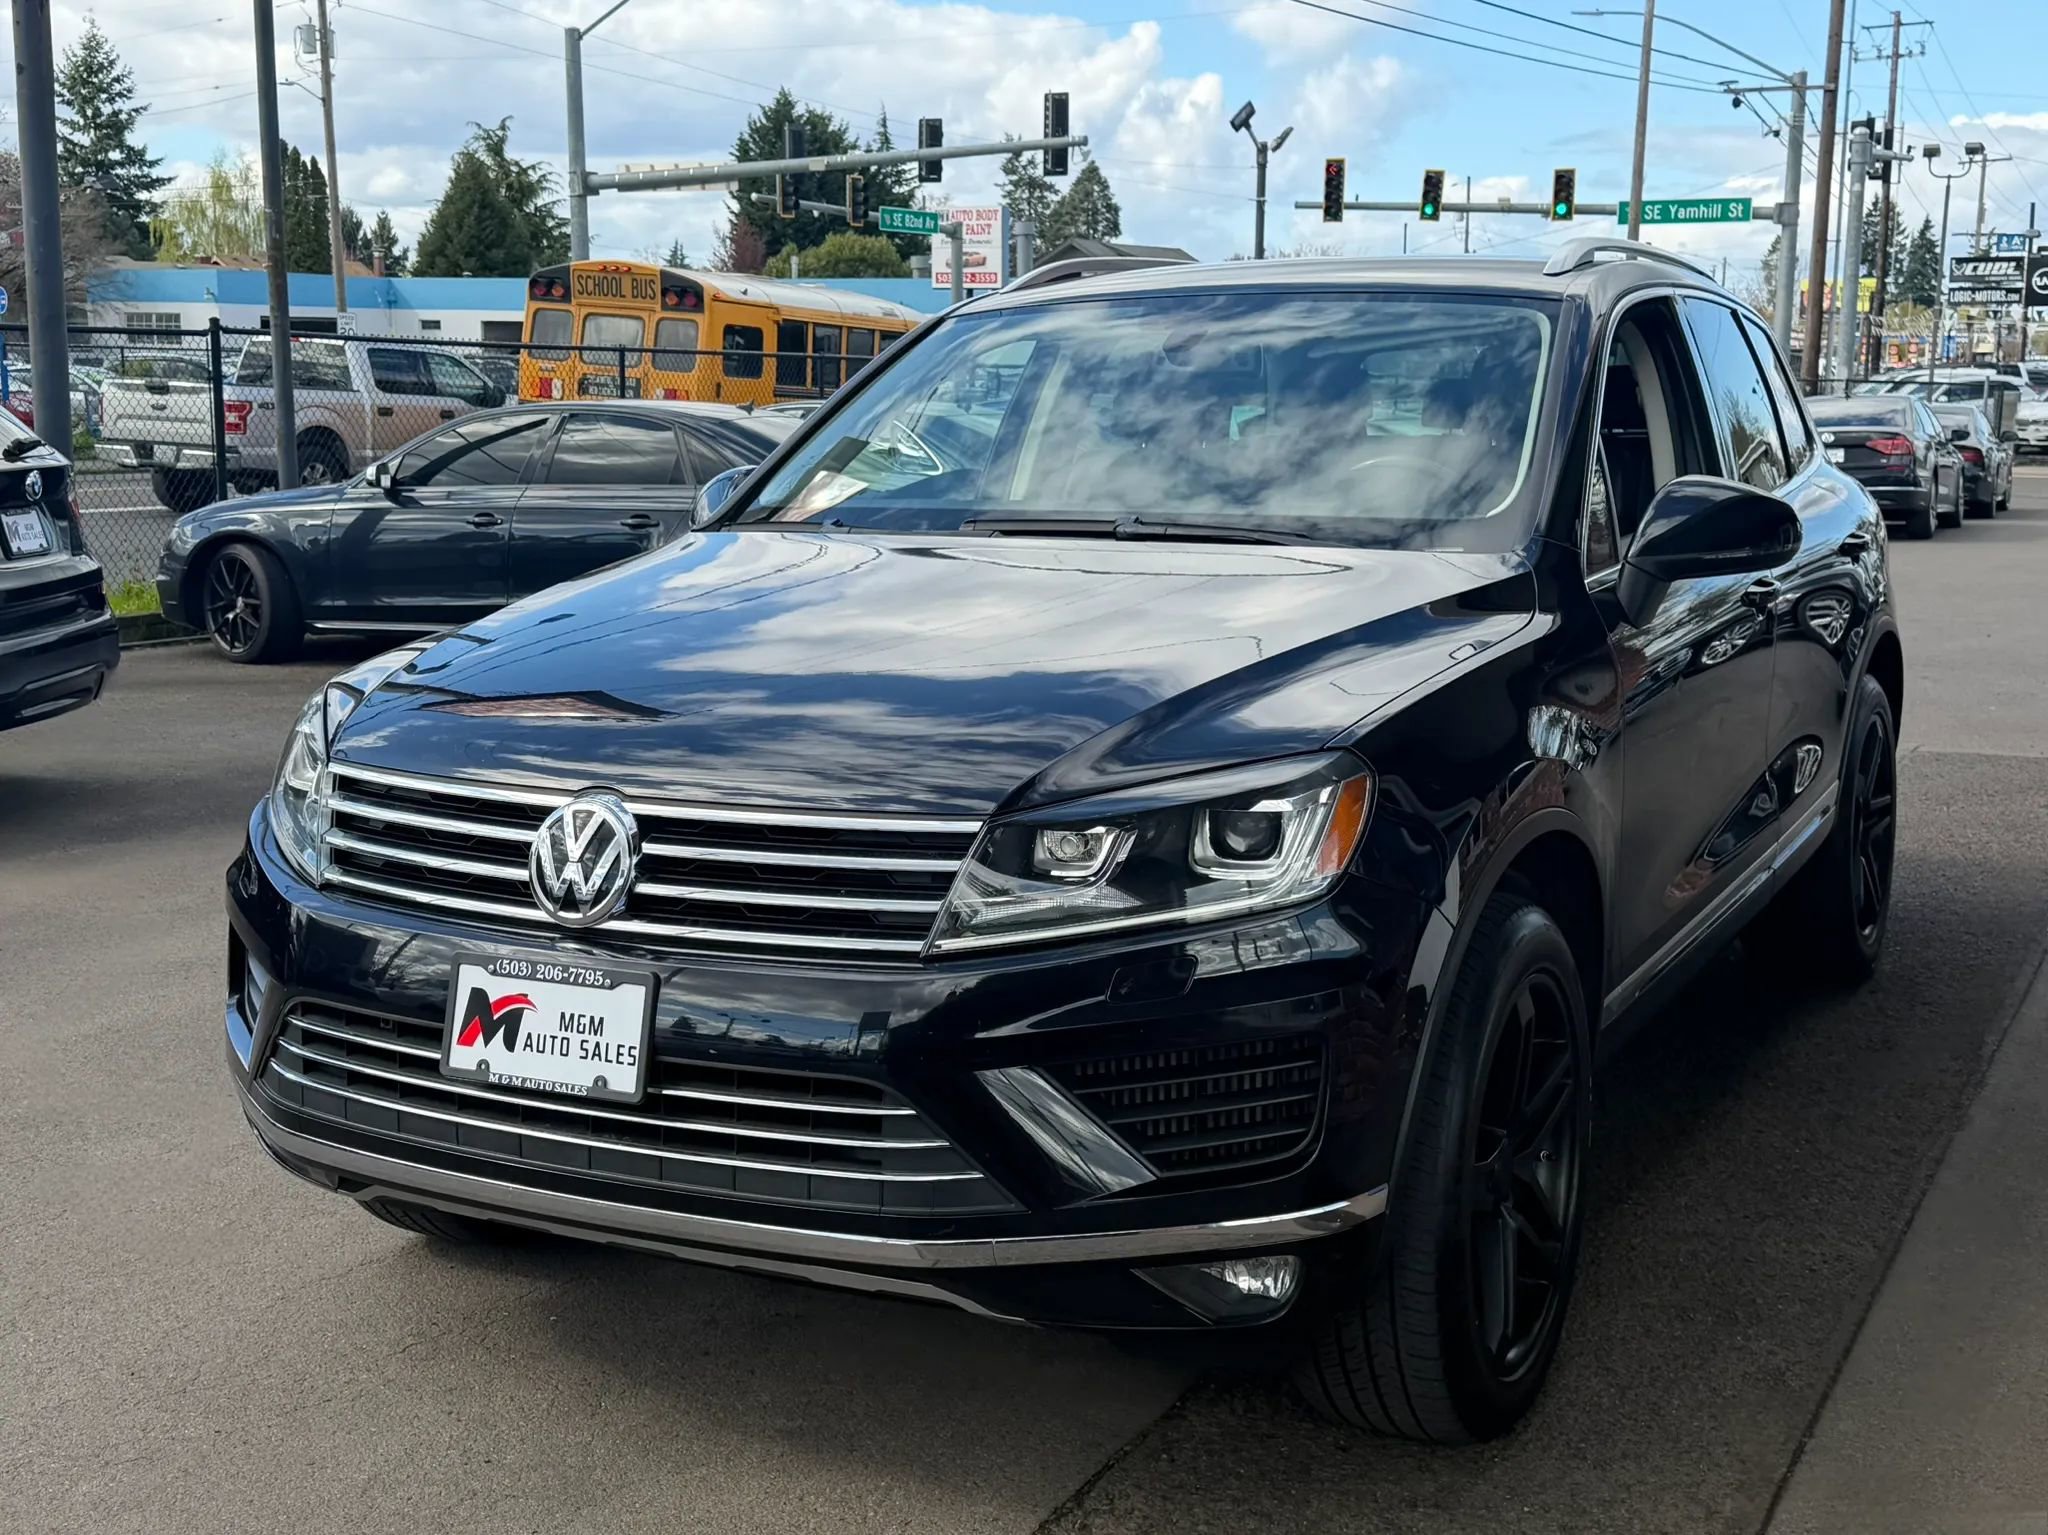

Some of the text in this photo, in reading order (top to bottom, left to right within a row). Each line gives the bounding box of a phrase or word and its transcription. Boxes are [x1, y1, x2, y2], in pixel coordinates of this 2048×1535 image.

[893, 213, 902, 227] SE
[905, 214, 923, 228] 82nd
[925, 216, 935, 229] Av
[951, 210, 974, 222] AUTO
[975, 209, 999, 221] BODY
[1644, 202, 1744, 220] SE Yamhill St
[965, 224, 992, 235] PAINT
[576, 274, 656, 300] SCHOOL BUS
[496, 959, 605, 986] (503) 206-7795
[559, 1011, 605, 1037] M&M
[522, 1032, 638, 1066] AUTO SALES
[488, 1073, 588, 1096] M & M AUTO SALES
